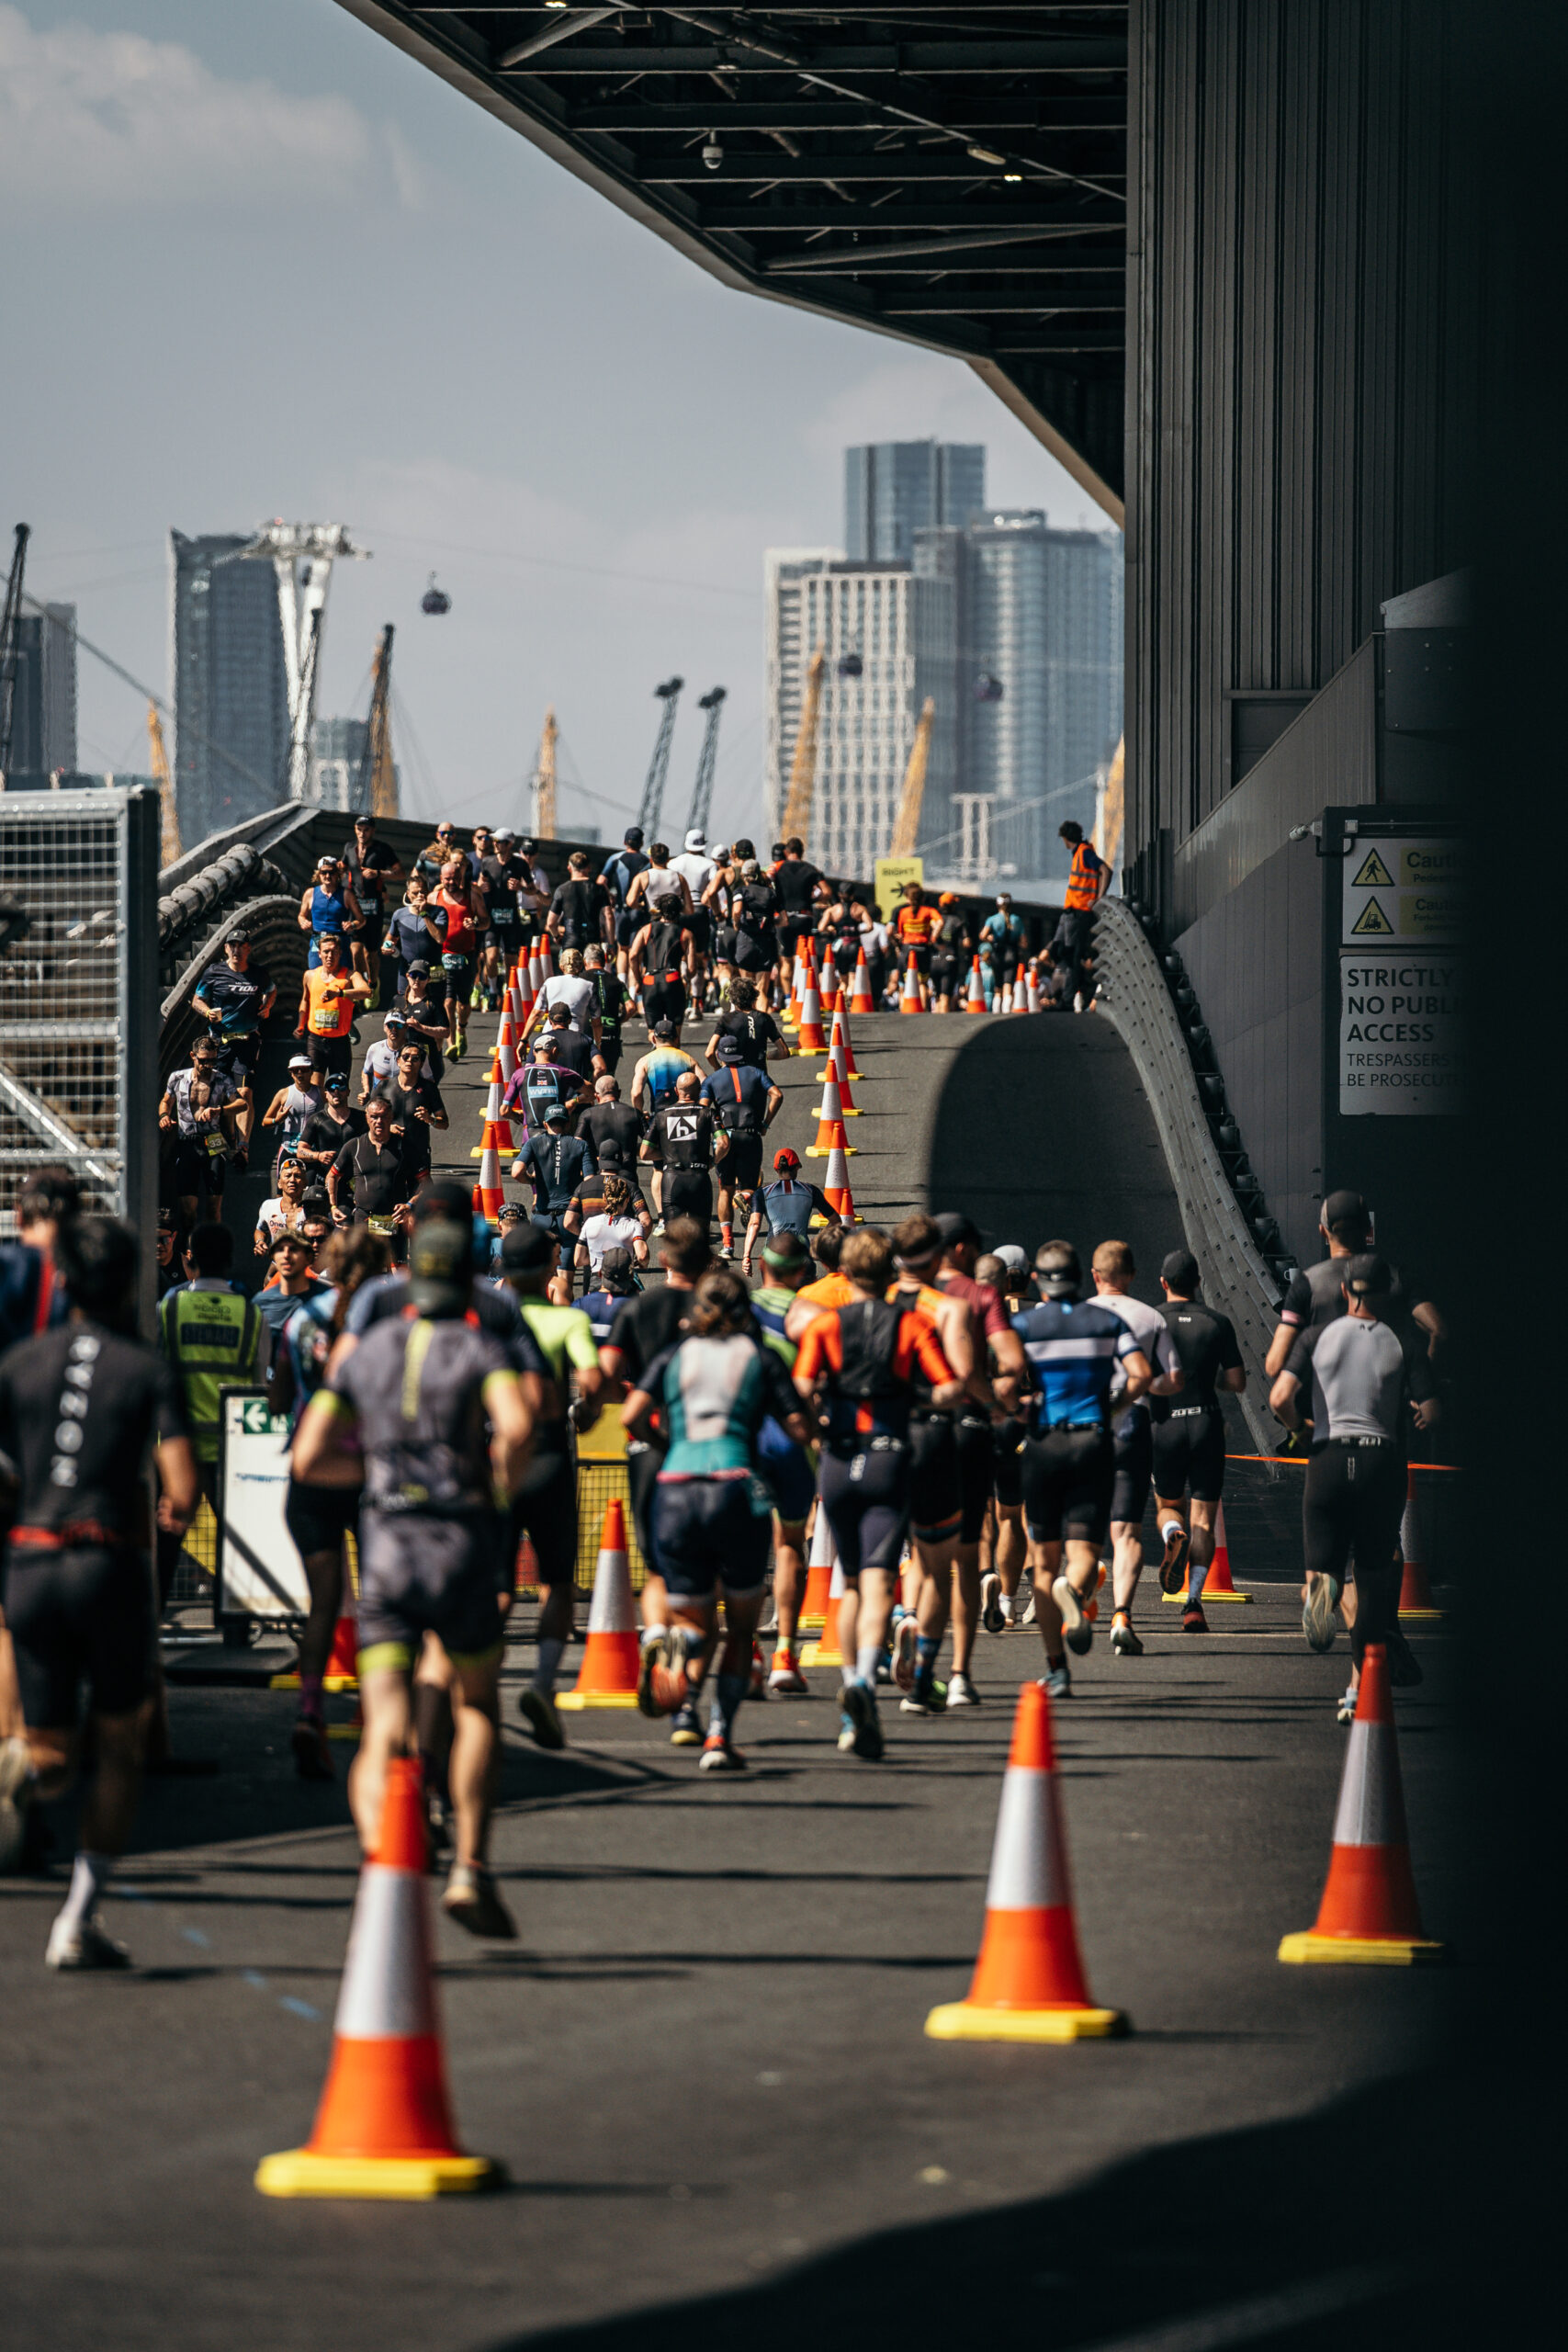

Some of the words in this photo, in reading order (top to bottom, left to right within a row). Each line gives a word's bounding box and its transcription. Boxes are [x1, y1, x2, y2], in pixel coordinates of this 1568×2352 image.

[1348, 968, 1454, 987] STRICTLY
[1348, 996, 1384, 1014] NO
[1347, 1024, 1434, 1042] ACCESS
[1347, 1054, 1450, 1067] TRESPASSERS
[1348, 1074, 1365, 1086] BE
[1171, 1407, 1201, 1418] ZONE3
